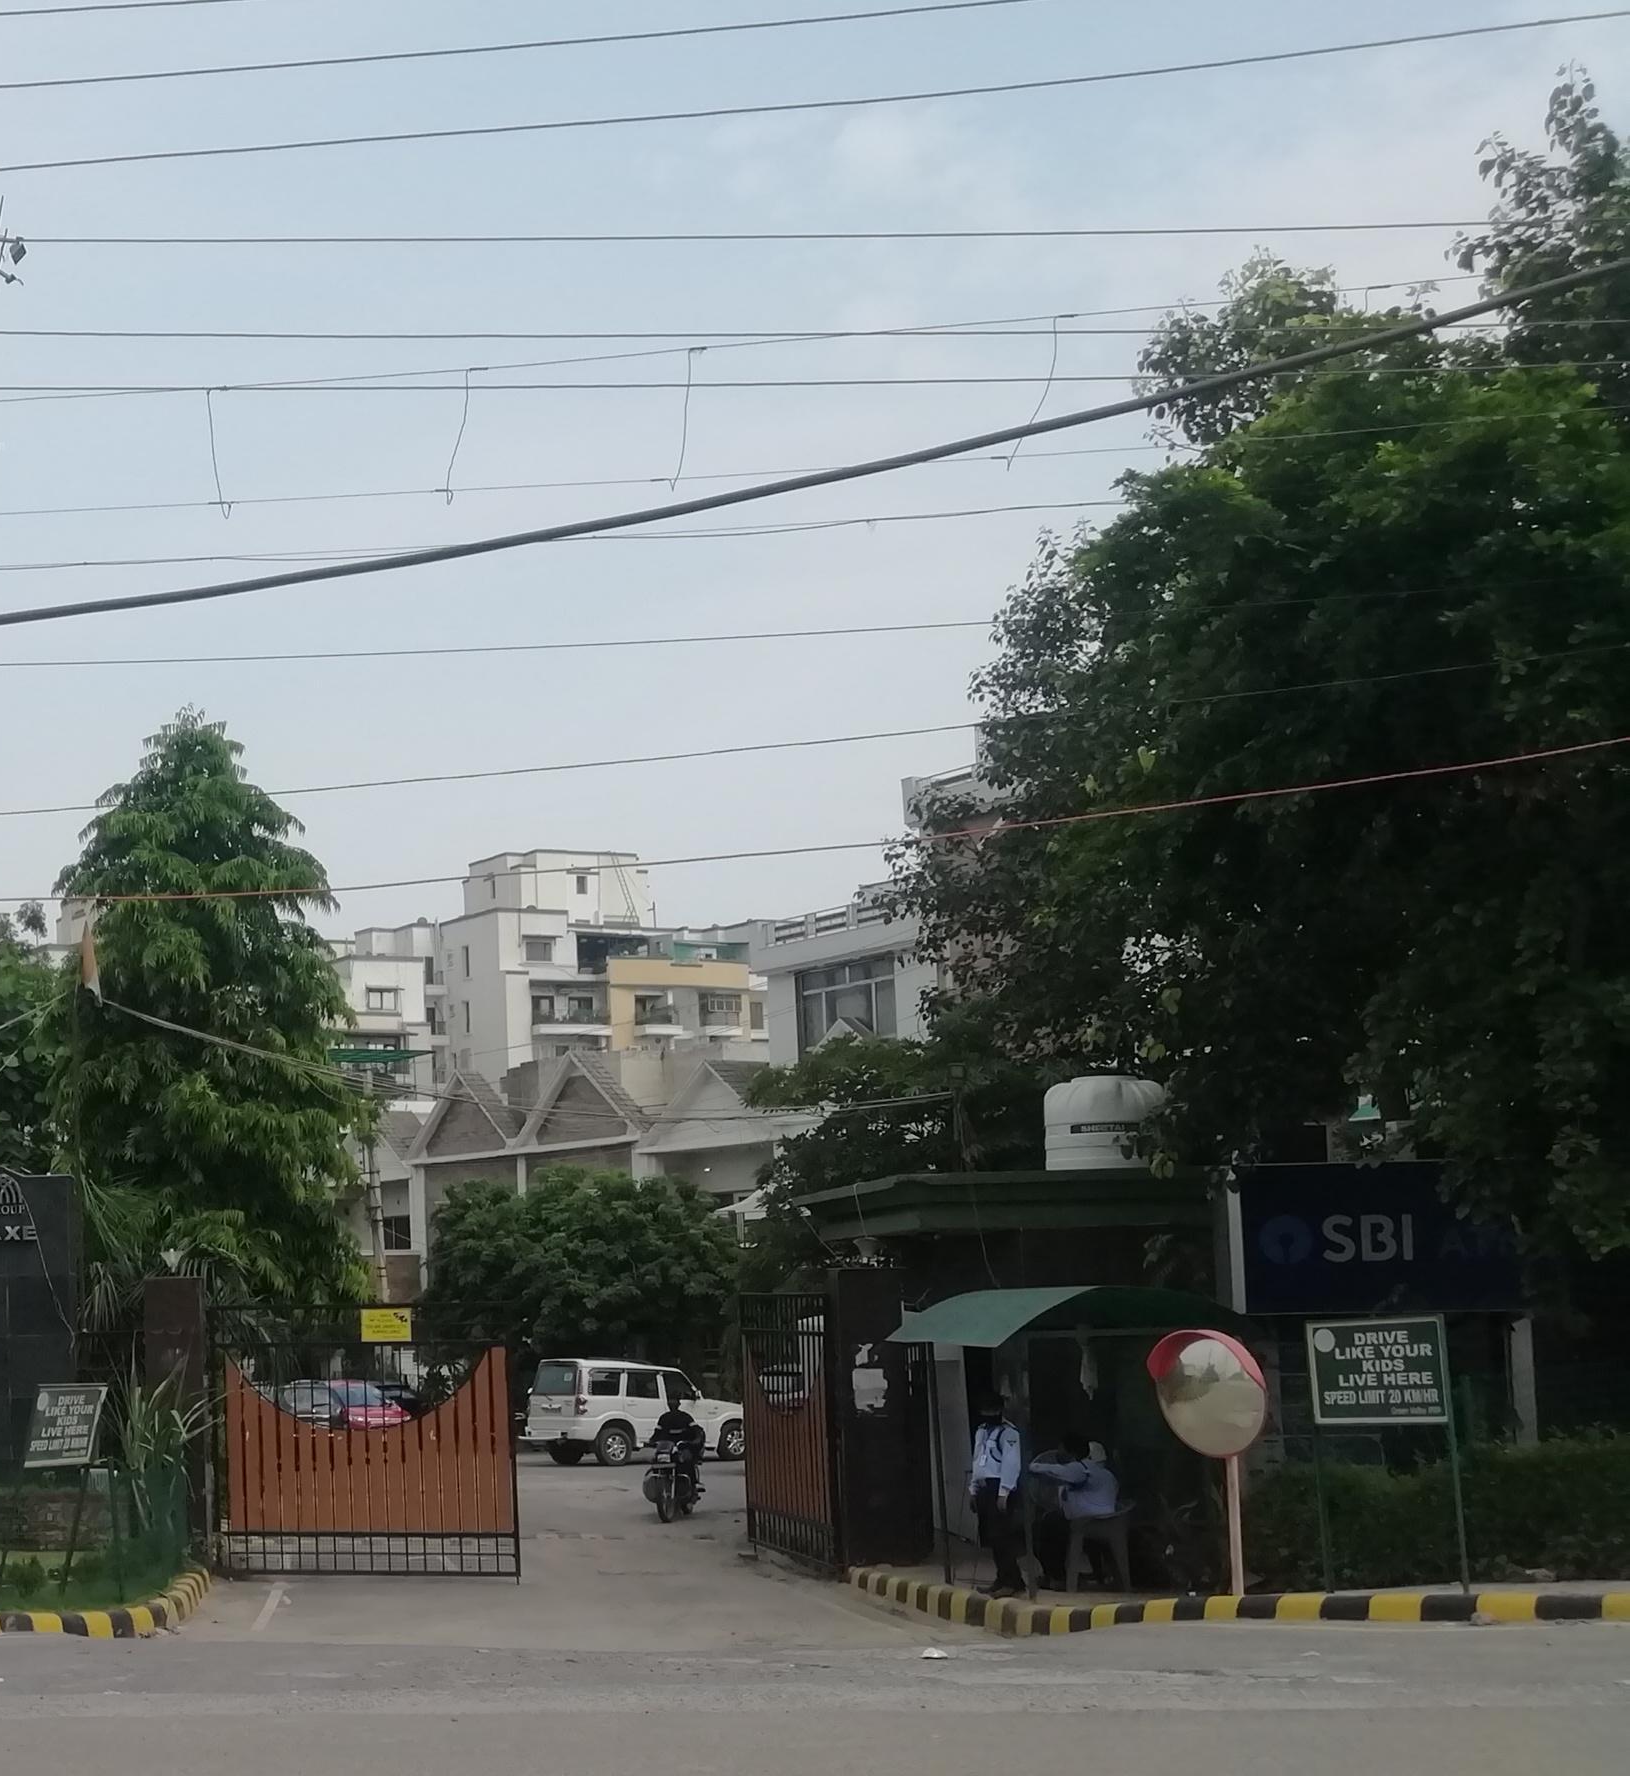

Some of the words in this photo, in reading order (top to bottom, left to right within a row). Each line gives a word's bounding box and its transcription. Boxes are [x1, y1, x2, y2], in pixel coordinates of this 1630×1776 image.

[1321, 1213, 1414, 1263] SBI
[1353, 1331, 1409, 1345] DRIVE
[1334, 1346, 1375, 1360] LIKE
[1380, 1343, 1433, 1358] YOUR
[1362, 1359, 1405, 1373] KIDS
[1338, 1373, 1378, 1387] LIVE
[1383, 1371, 1434, 1385] HERE
[58, 1395, 86, 1406] DRIVE
[1324, 1391, 1356, 1405] SPEED
[1358, 1389, 1386, 1404] LIMIT
[1388, 1389, 1402, 1404] 20
[45, 1406, 67, 1417] LIKE
[69, 1405, 94, 1415] YOUR
[56, 1416, 79, 1427] KIDS
[41, 1427, 63, 1438] LIVE
[64, 1425, 89, 1436] HERE
